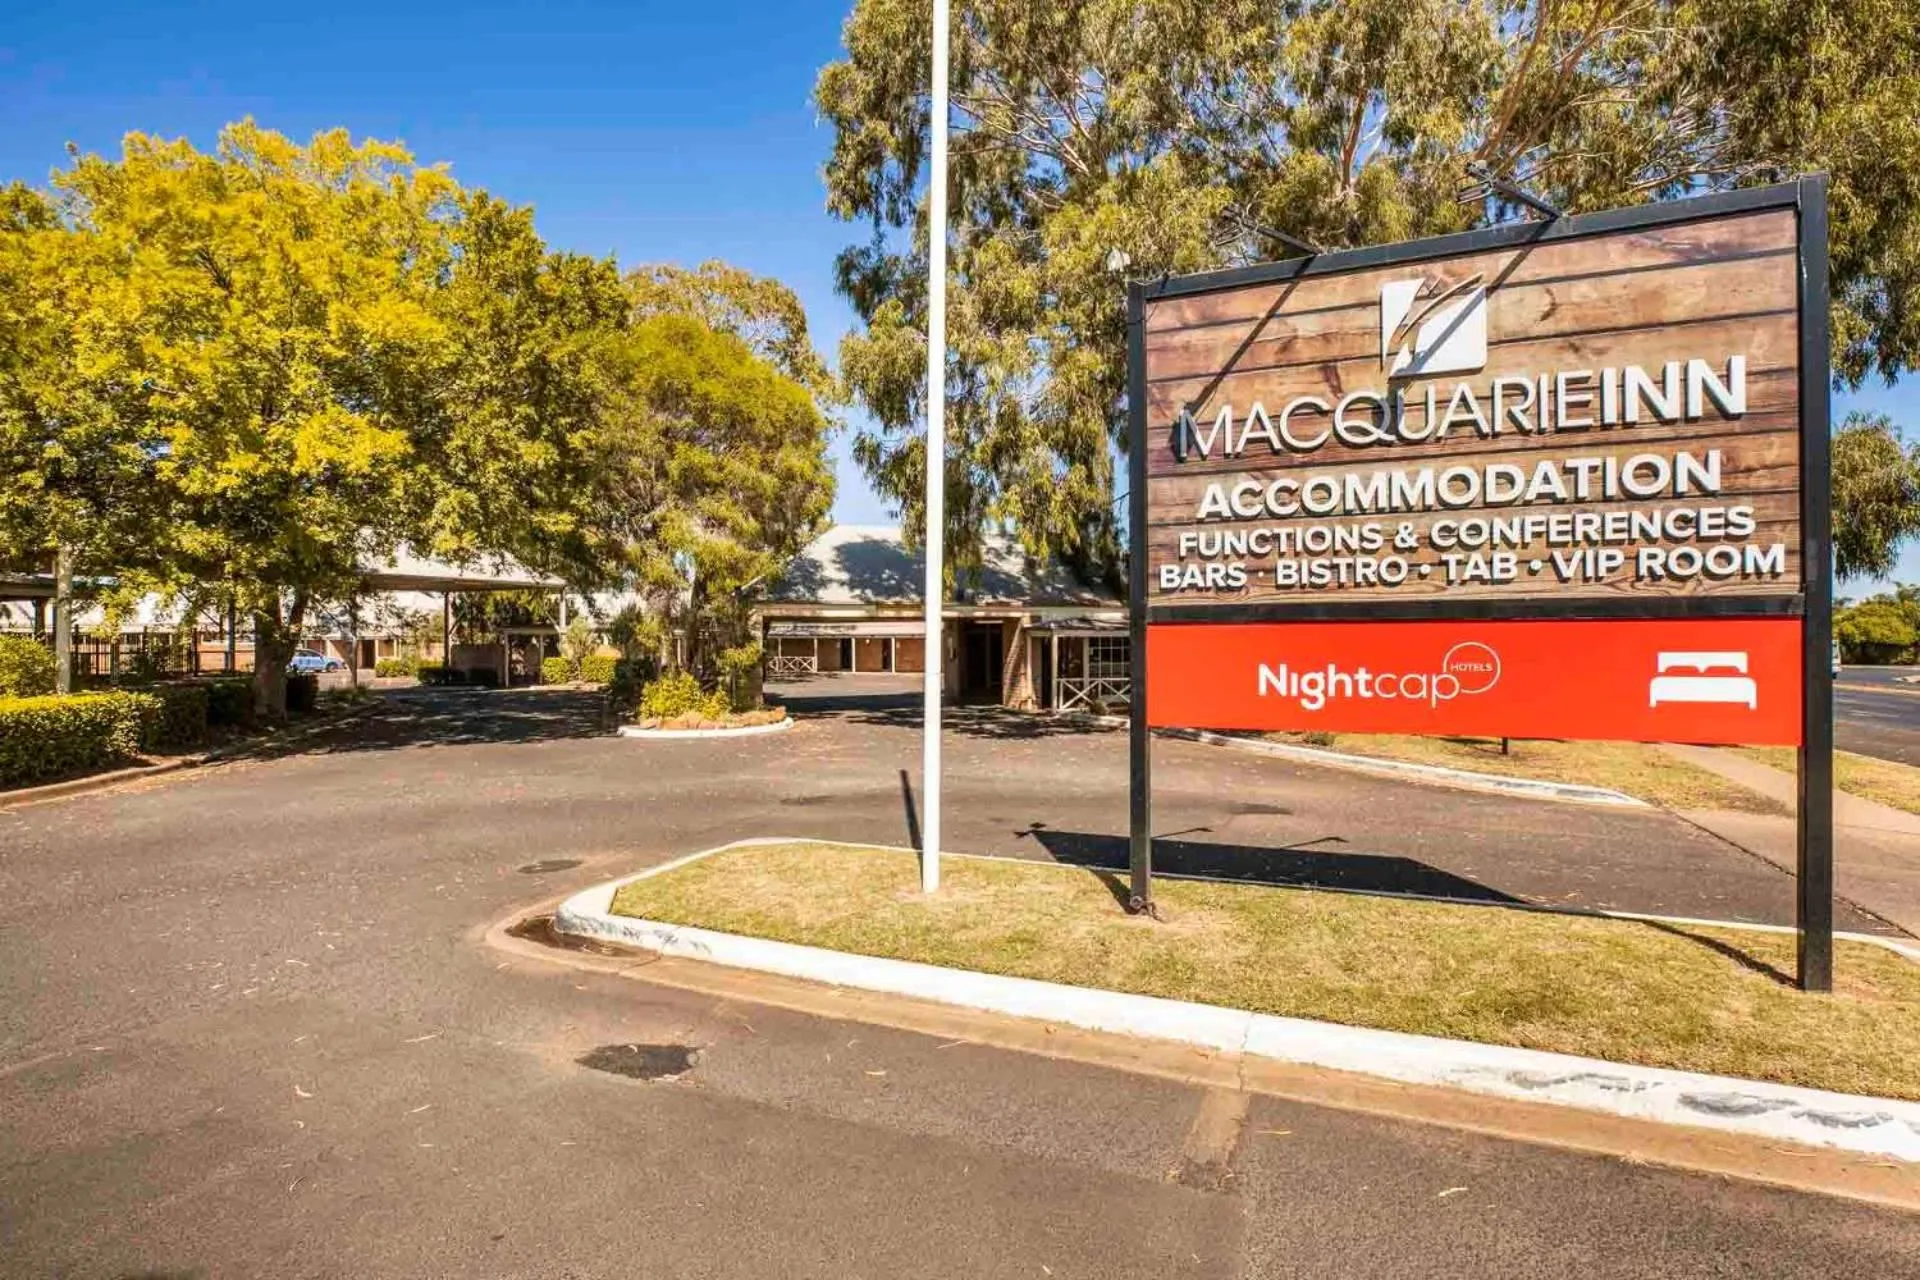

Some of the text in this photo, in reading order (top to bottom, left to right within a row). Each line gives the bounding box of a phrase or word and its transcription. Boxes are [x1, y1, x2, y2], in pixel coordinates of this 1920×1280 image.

[1197, 449, 1721, 519] ACCOMMODATION
[1178, 505, 1757, 558] FUNCTIONS & CONFERENCES
[1159, 543, 1785, 591] BARS BISTRO TAB VIP ROOM
[1257, 662, 1460, 711] Nightcap
[1450, 661, 1493, 673] HOTELS
